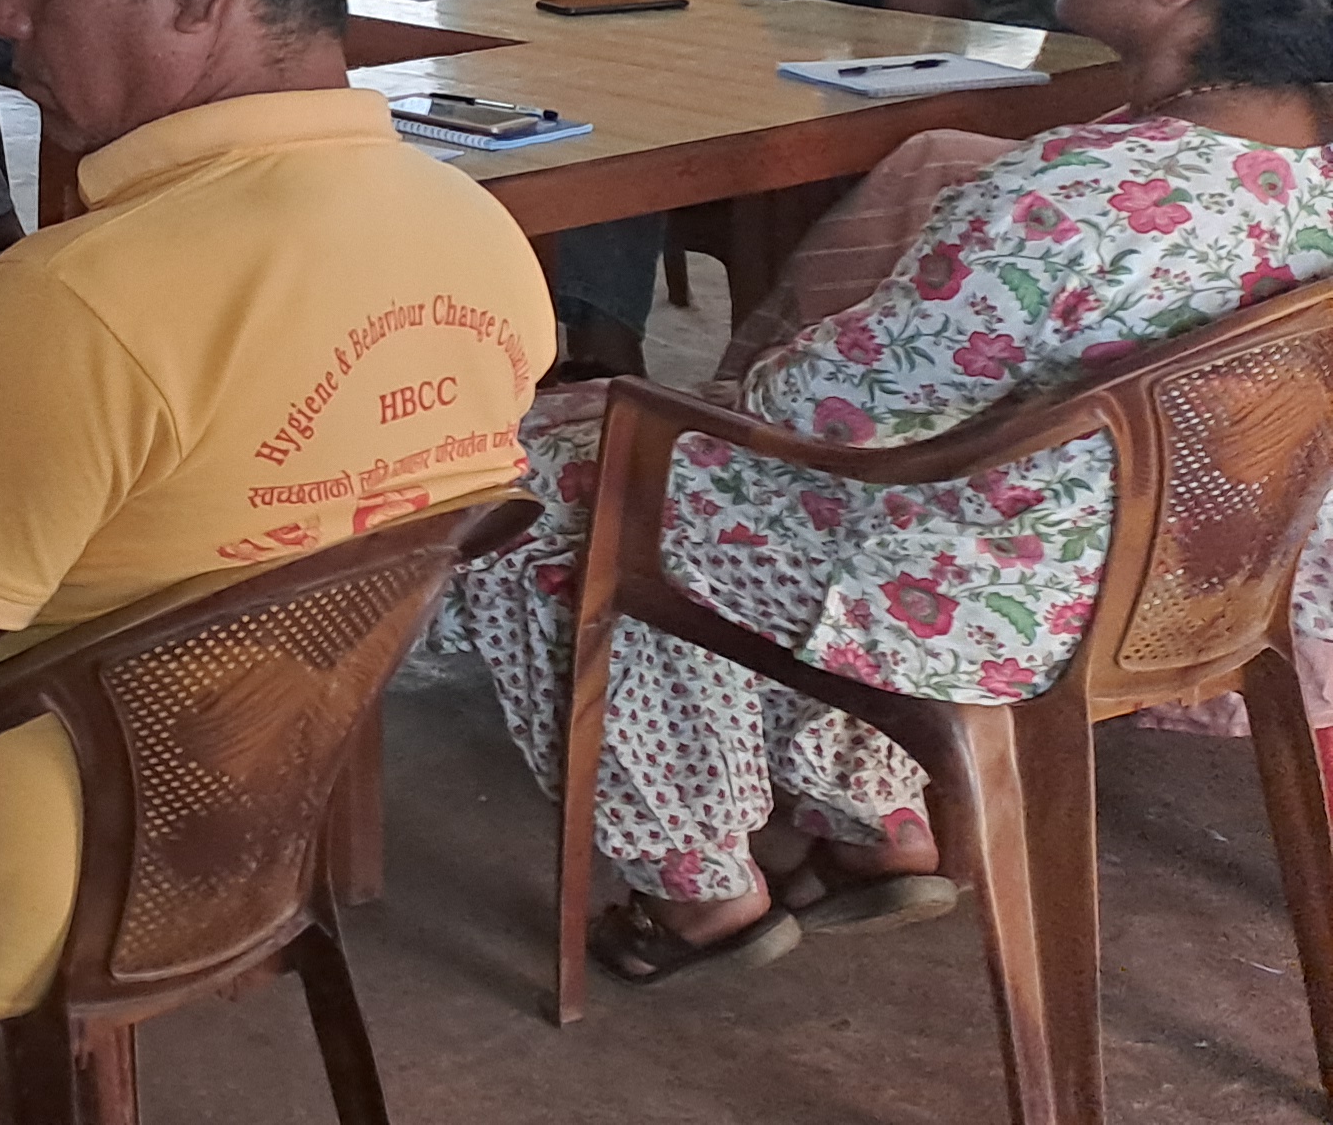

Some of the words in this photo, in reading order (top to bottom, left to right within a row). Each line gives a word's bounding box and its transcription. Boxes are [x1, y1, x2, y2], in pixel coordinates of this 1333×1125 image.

[254, 371, 339, 466] Hygiene
[334, 347, 352, 376] &
[348, 299, 426, 361] Behaviour
[433, 294, 496, 343] Change
[379, 376, 458, 424] HBCC
[247, 470, 354, 508] स्वच्छताको
